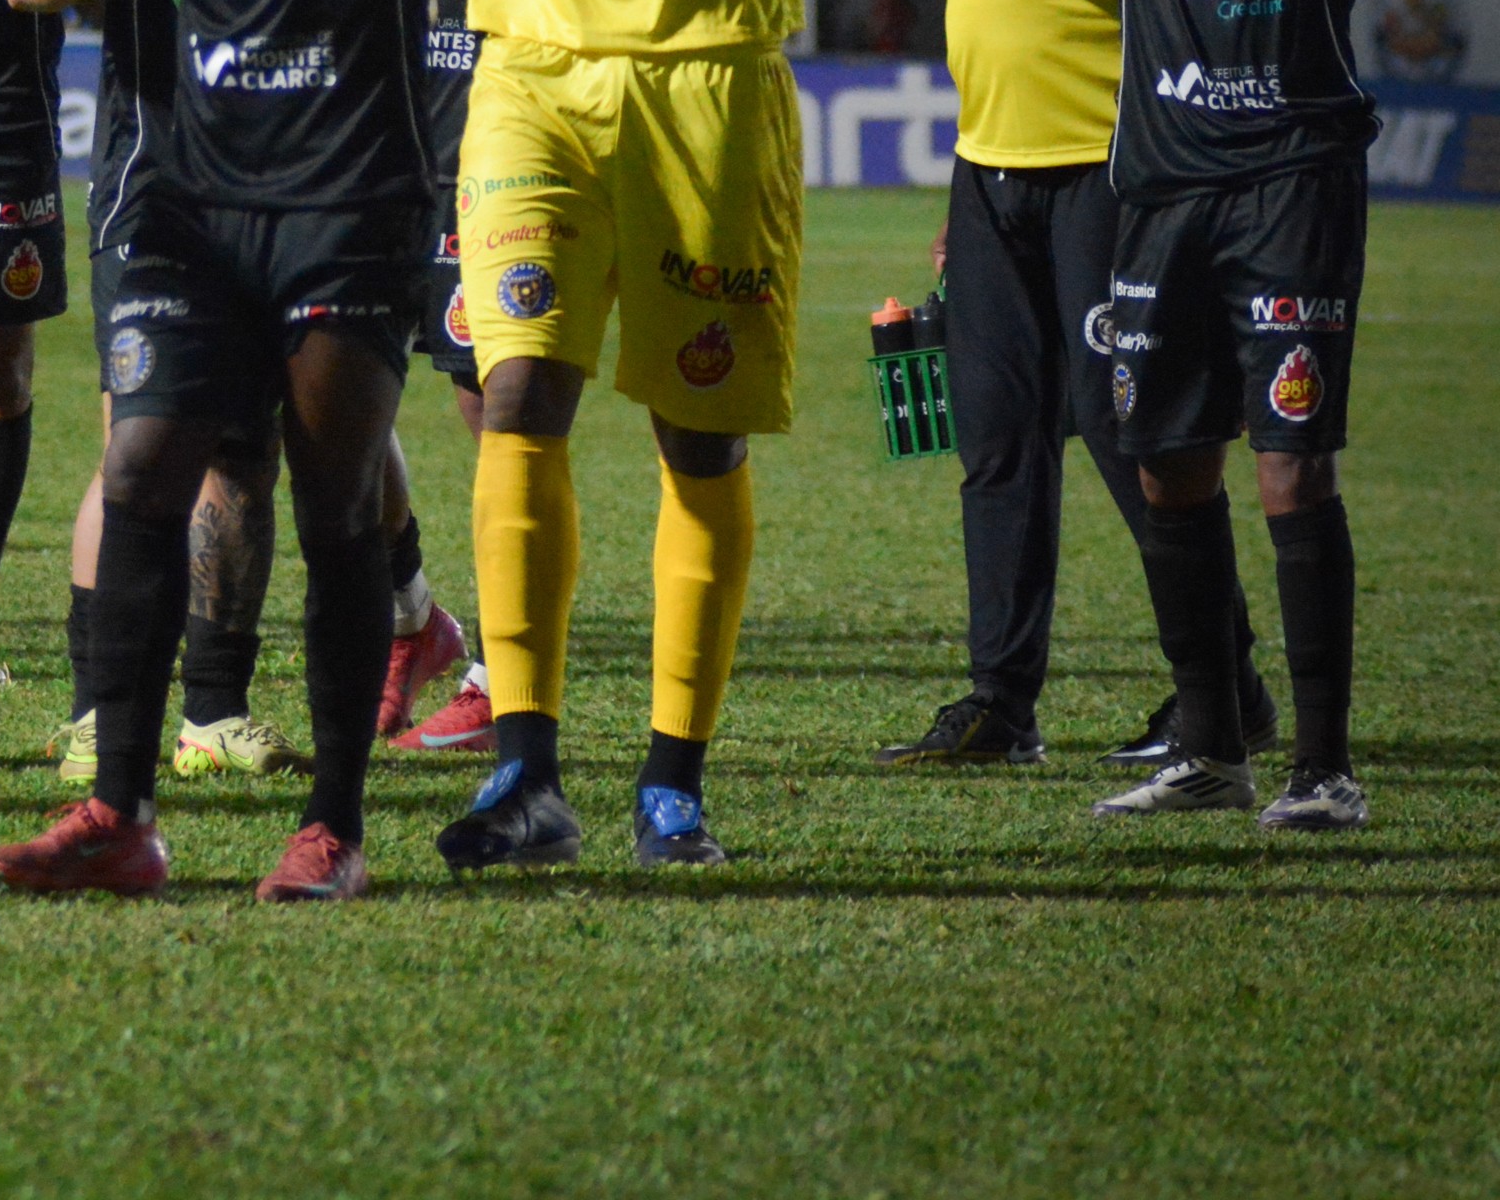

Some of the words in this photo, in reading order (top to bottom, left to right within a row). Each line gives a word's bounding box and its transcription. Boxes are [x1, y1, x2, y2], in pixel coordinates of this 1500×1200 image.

[427, 32, 476, 51] NTES
[240, 68, 337, 90] CLAROS
[1263, 64, 1279, 77] DE
[486, 224, 544, 249] Center
[660, 249, 772, 294] INOVAR
